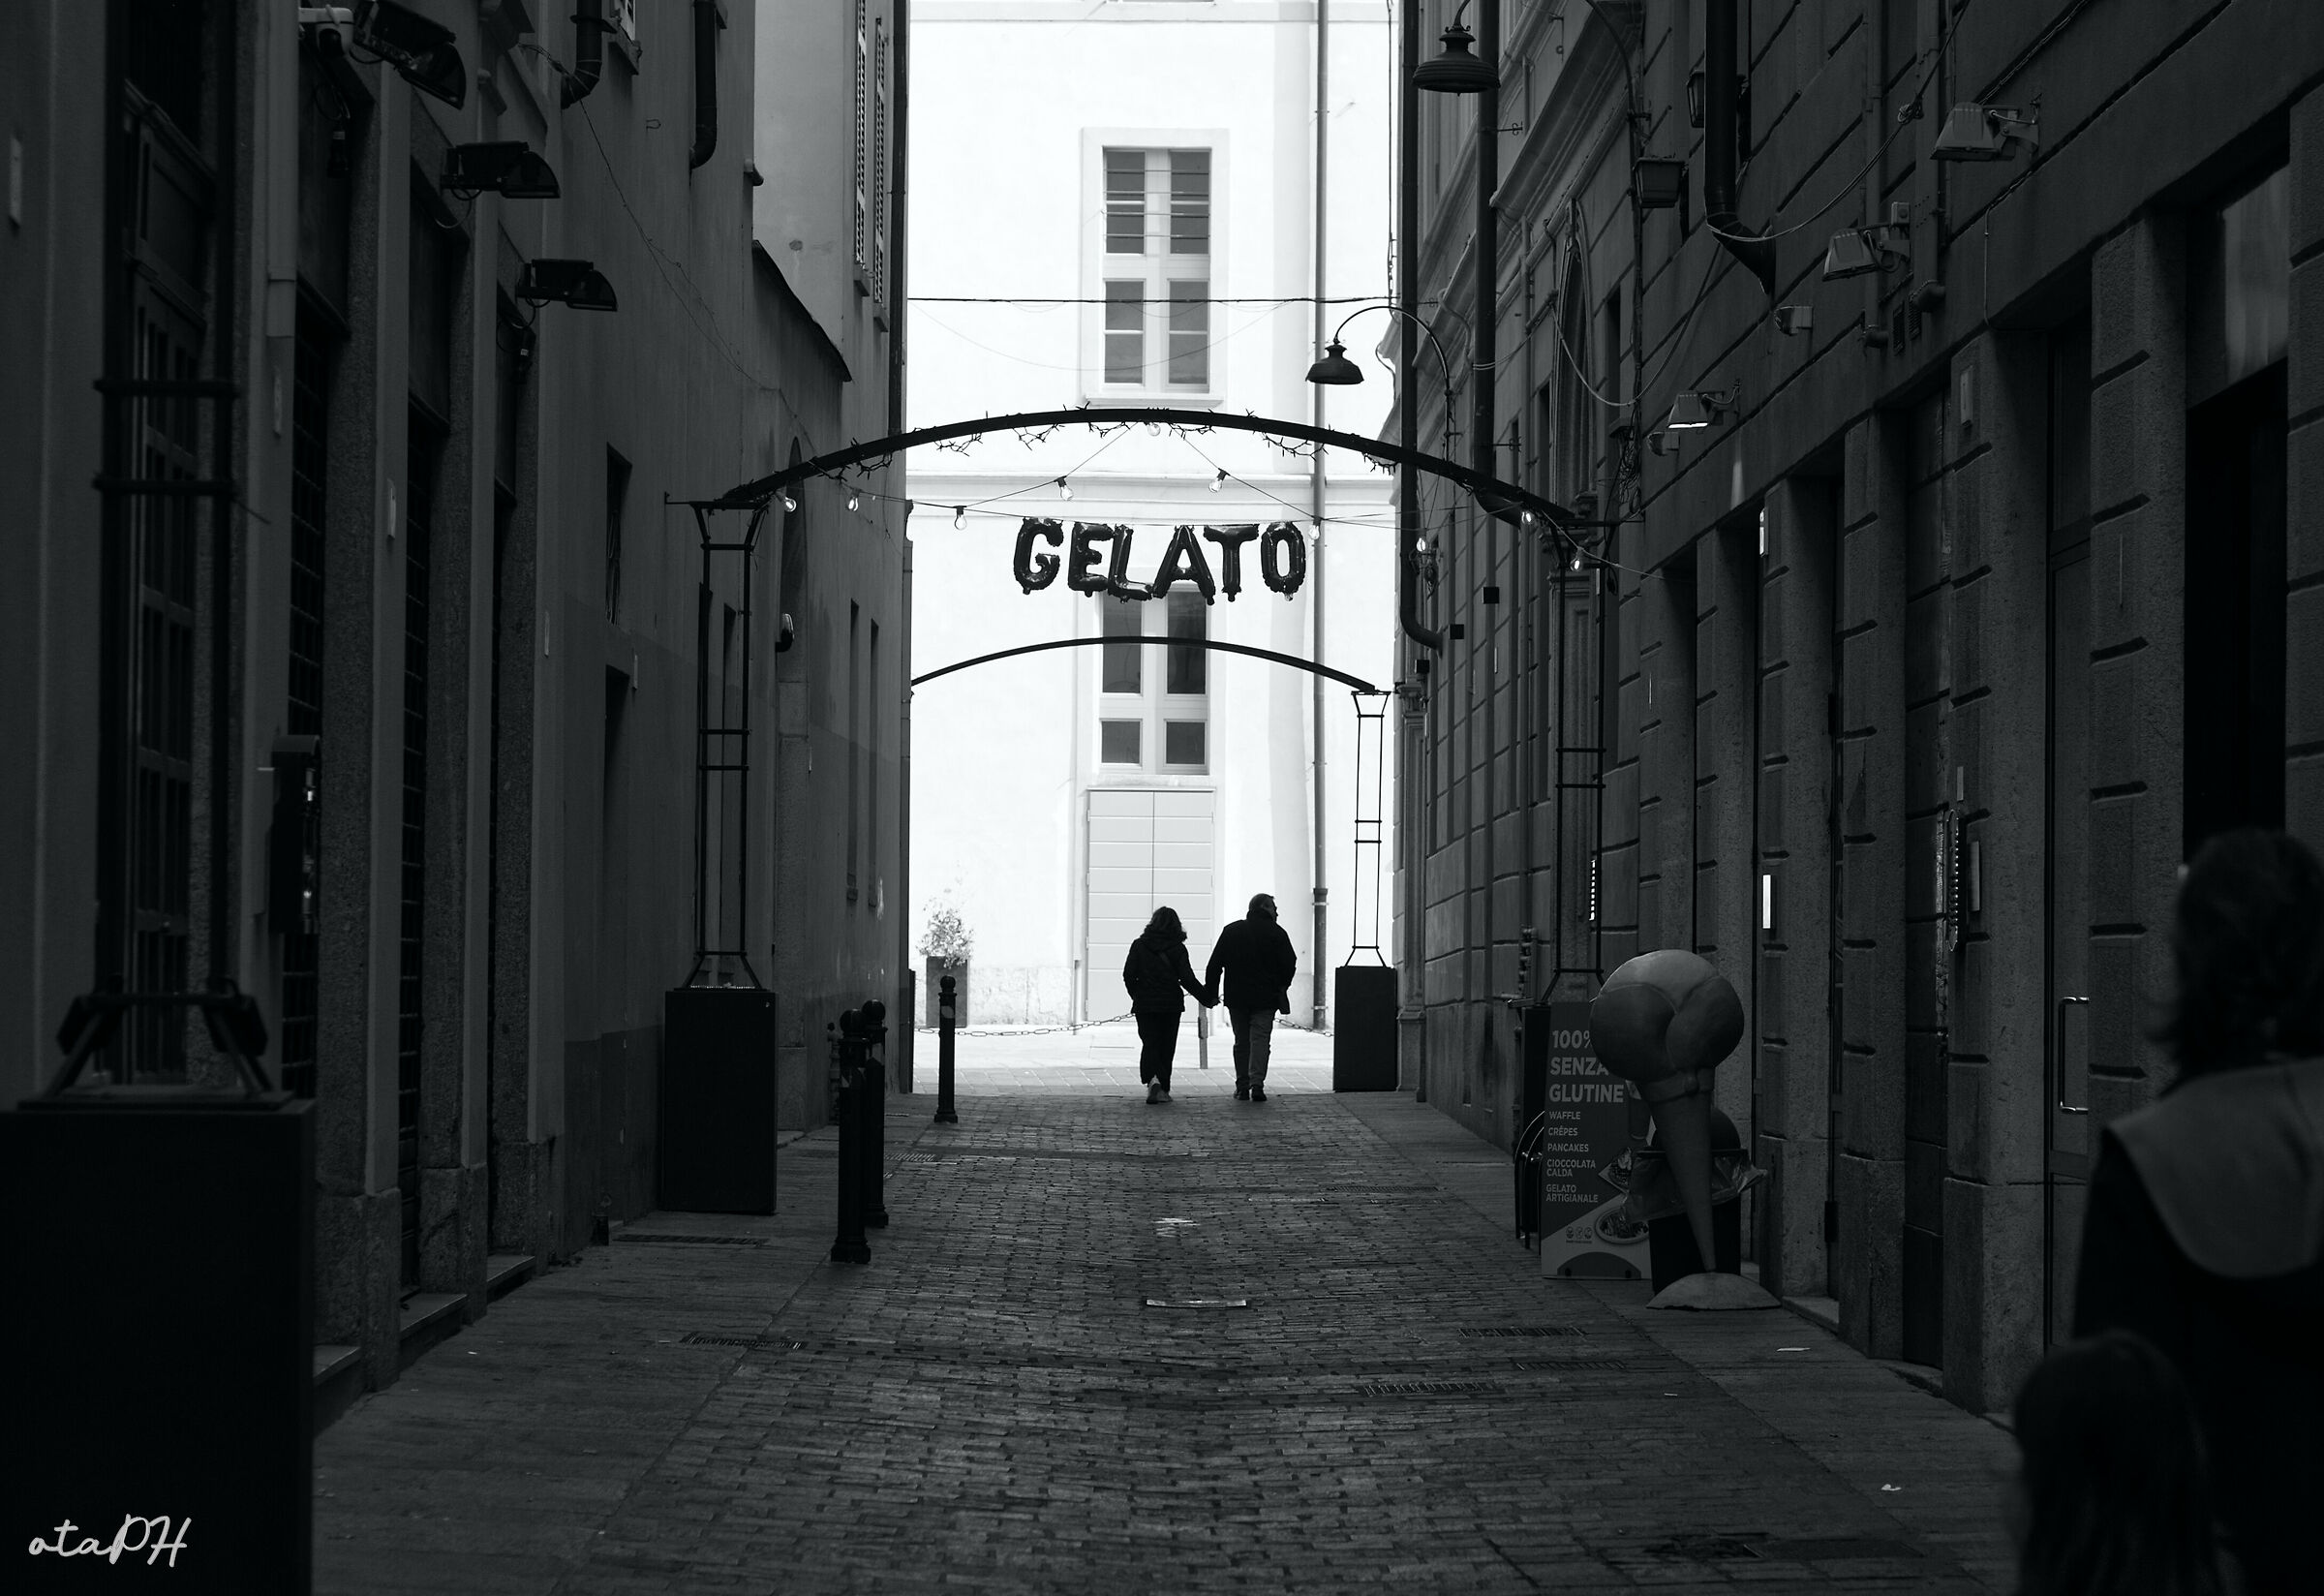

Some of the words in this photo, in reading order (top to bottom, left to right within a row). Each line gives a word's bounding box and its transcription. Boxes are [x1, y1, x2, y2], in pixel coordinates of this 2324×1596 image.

[1014, 516, 1306, 604] GELATO
[1550, 1057, 1609, 1076] SENZA
[1549, 1084, 1625, 1103] GLUTINE
[1549, 1111, 1581, 1120] WAFFLE
[1547, 1143, 1589, 1152] PANCAKES
[1546, 1158, 1597, 1169] CIOCCOLATA
[1546, 1168, 1574, 1178] CALDA
[1545, 1184, 1577, 1193] GELATO
[1545, 1193, 1599, 1203] ARTIGIANALE
